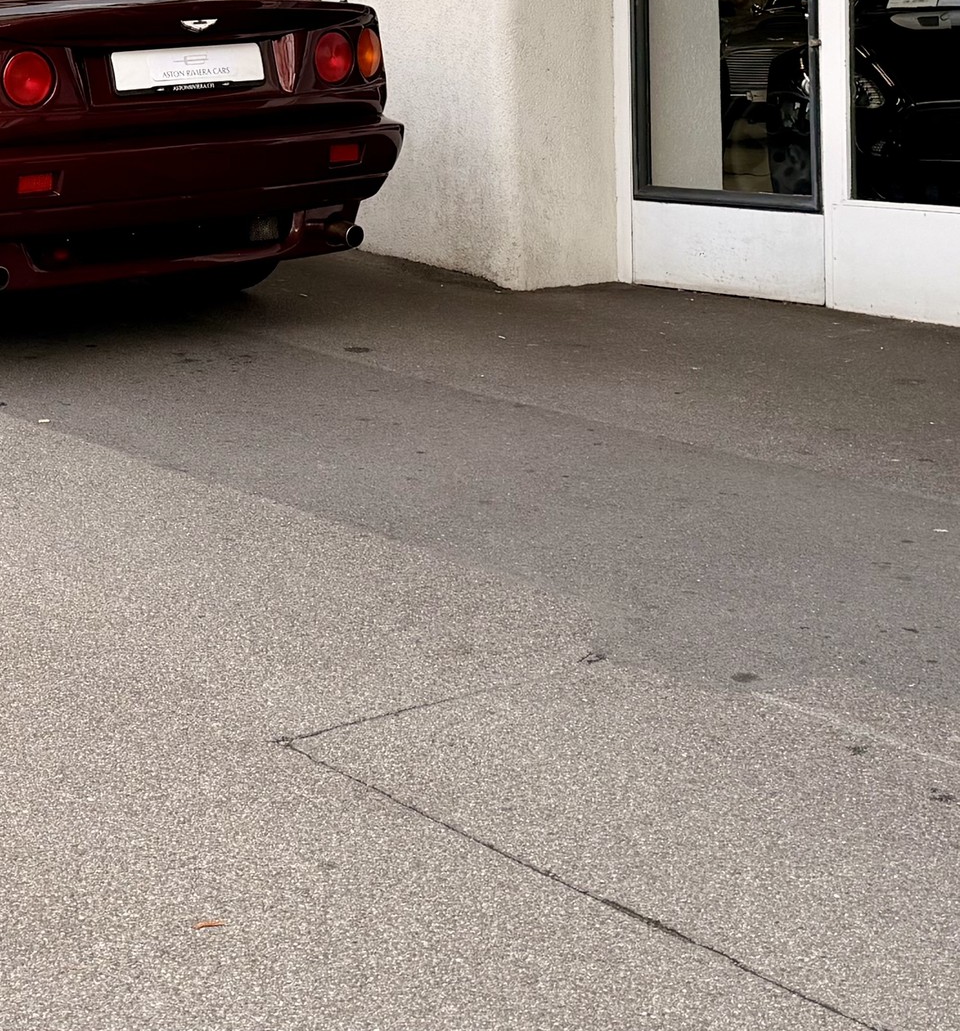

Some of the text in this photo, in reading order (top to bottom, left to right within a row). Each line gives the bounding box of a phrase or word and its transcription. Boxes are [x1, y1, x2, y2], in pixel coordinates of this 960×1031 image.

[162, 66, 231, 79] ASTON RIVIERA CARS
